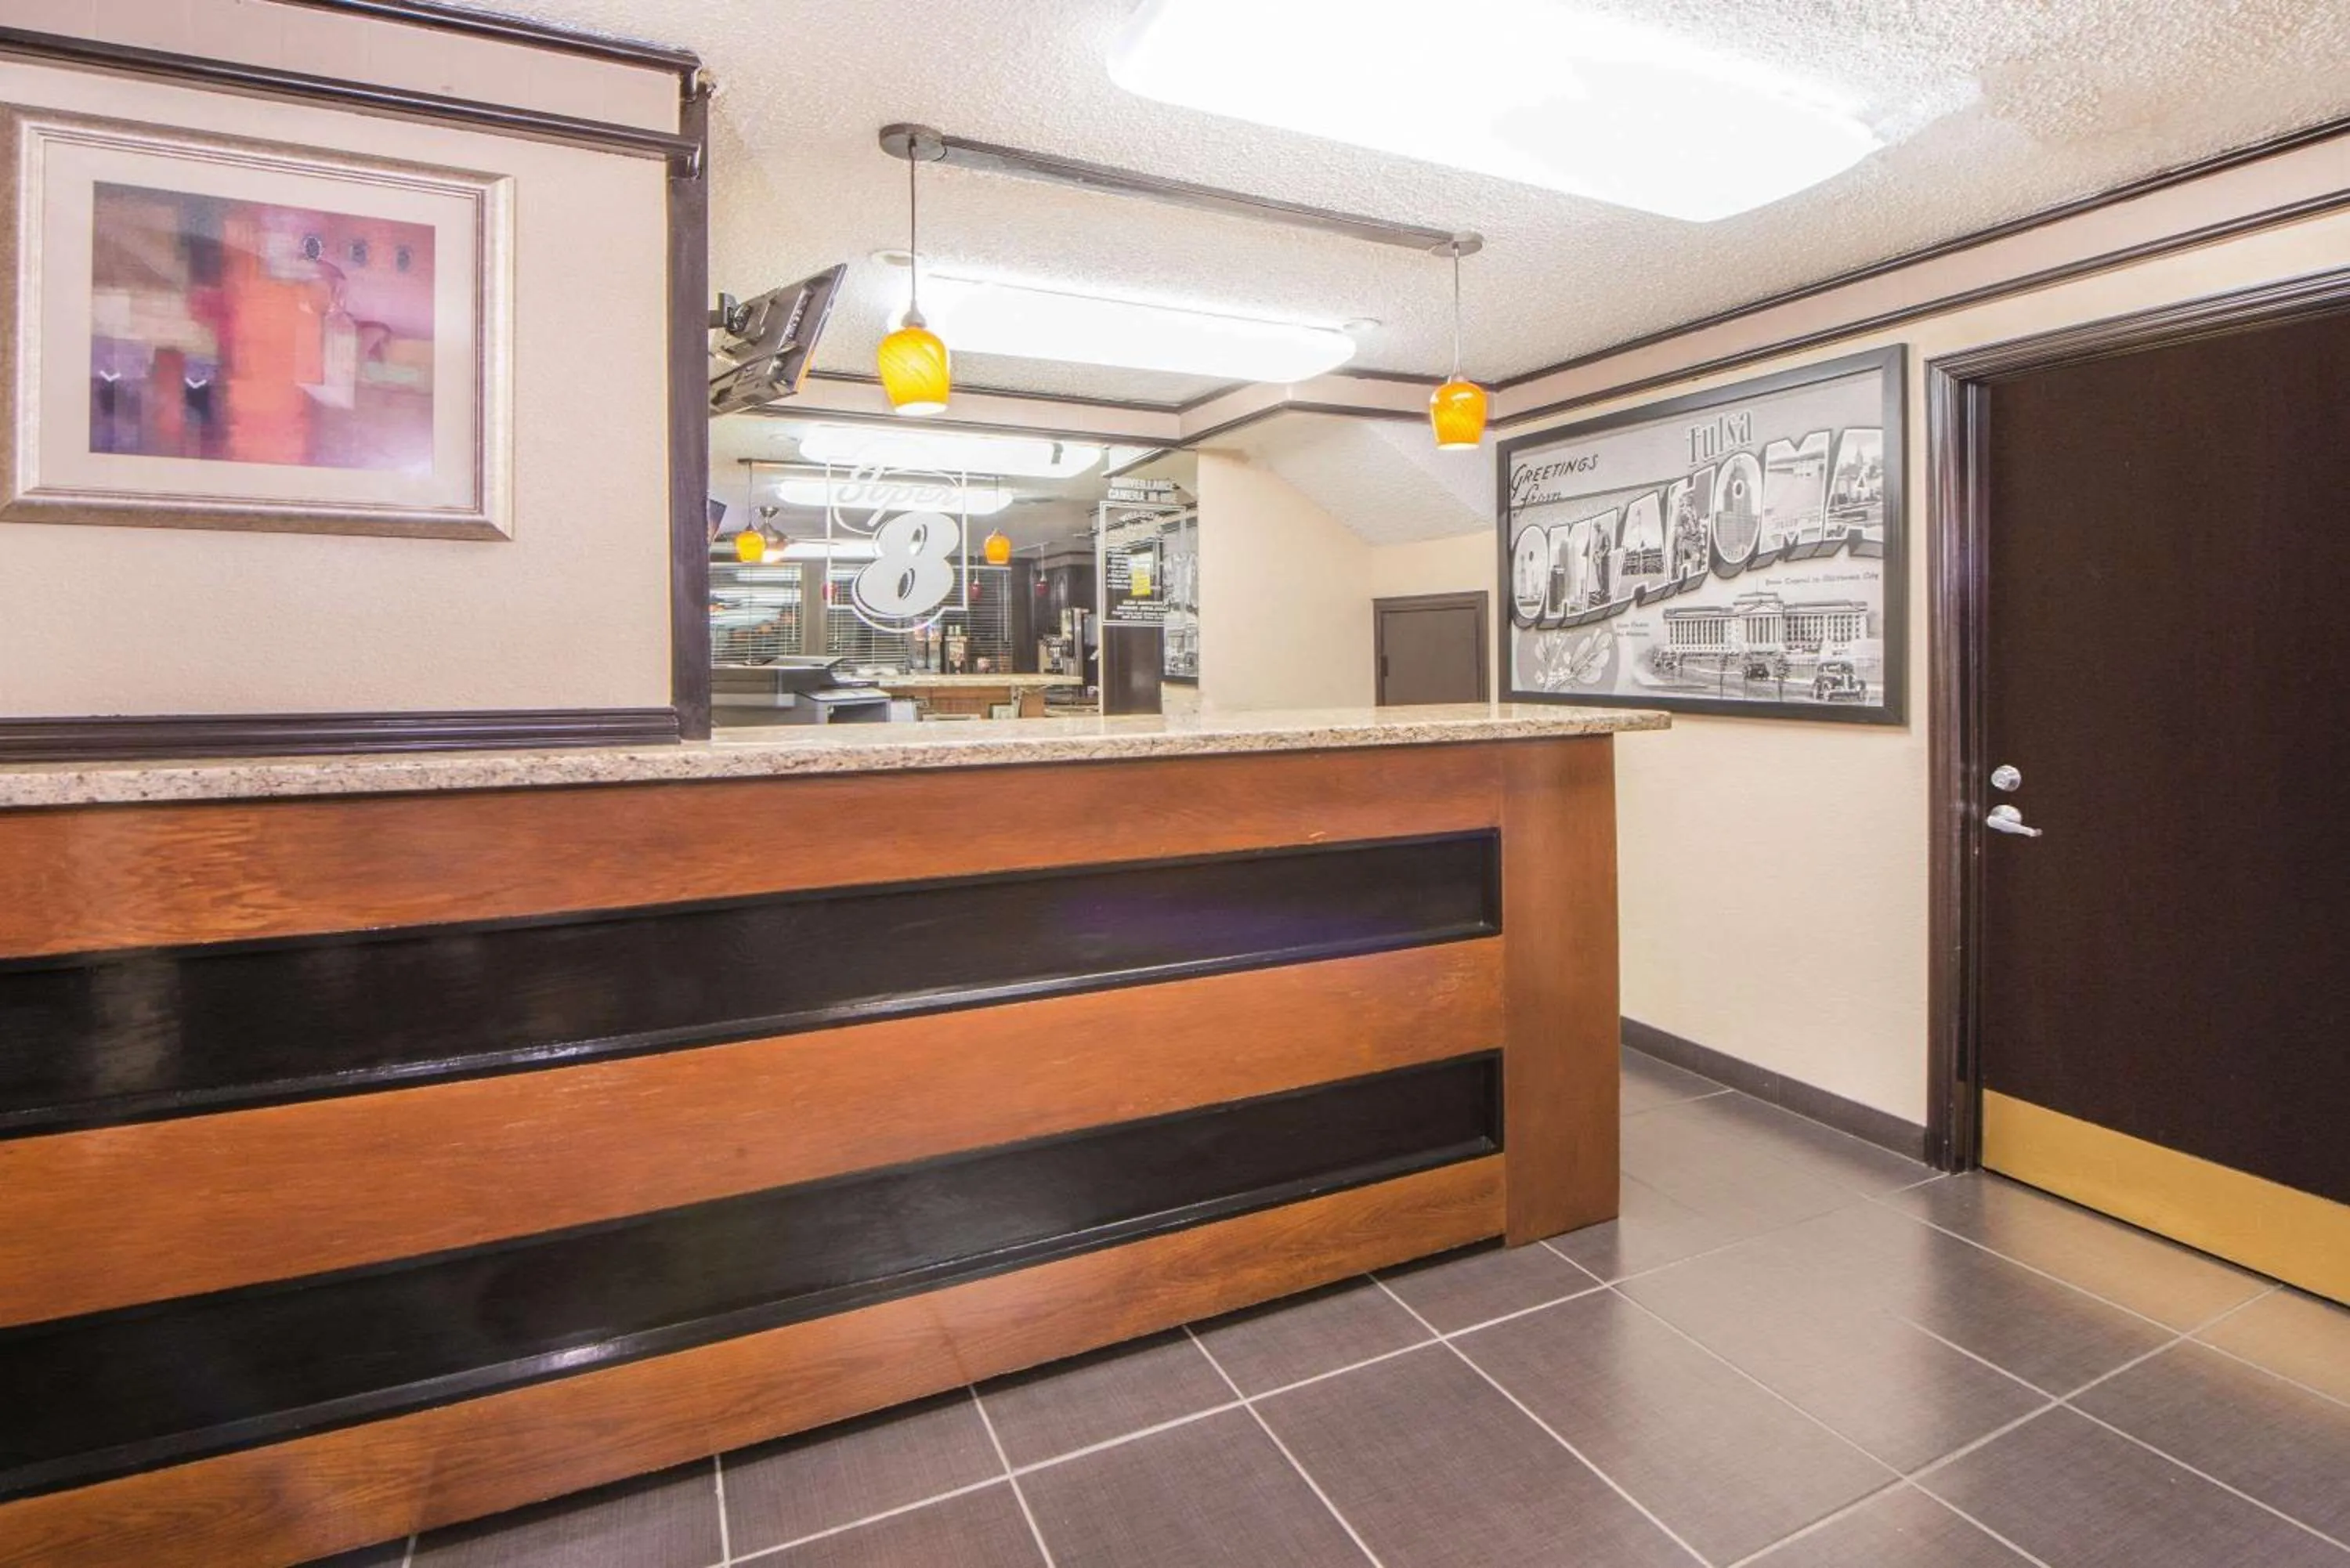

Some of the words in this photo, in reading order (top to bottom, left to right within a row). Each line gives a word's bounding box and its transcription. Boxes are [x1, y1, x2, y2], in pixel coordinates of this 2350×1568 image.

[833, 462, 961, 533] Super
[1511, 428, 1883, 627] OKLAHOMA
[1513, 483, 1561, 517] from
[852, 511, 960, 617] 8
